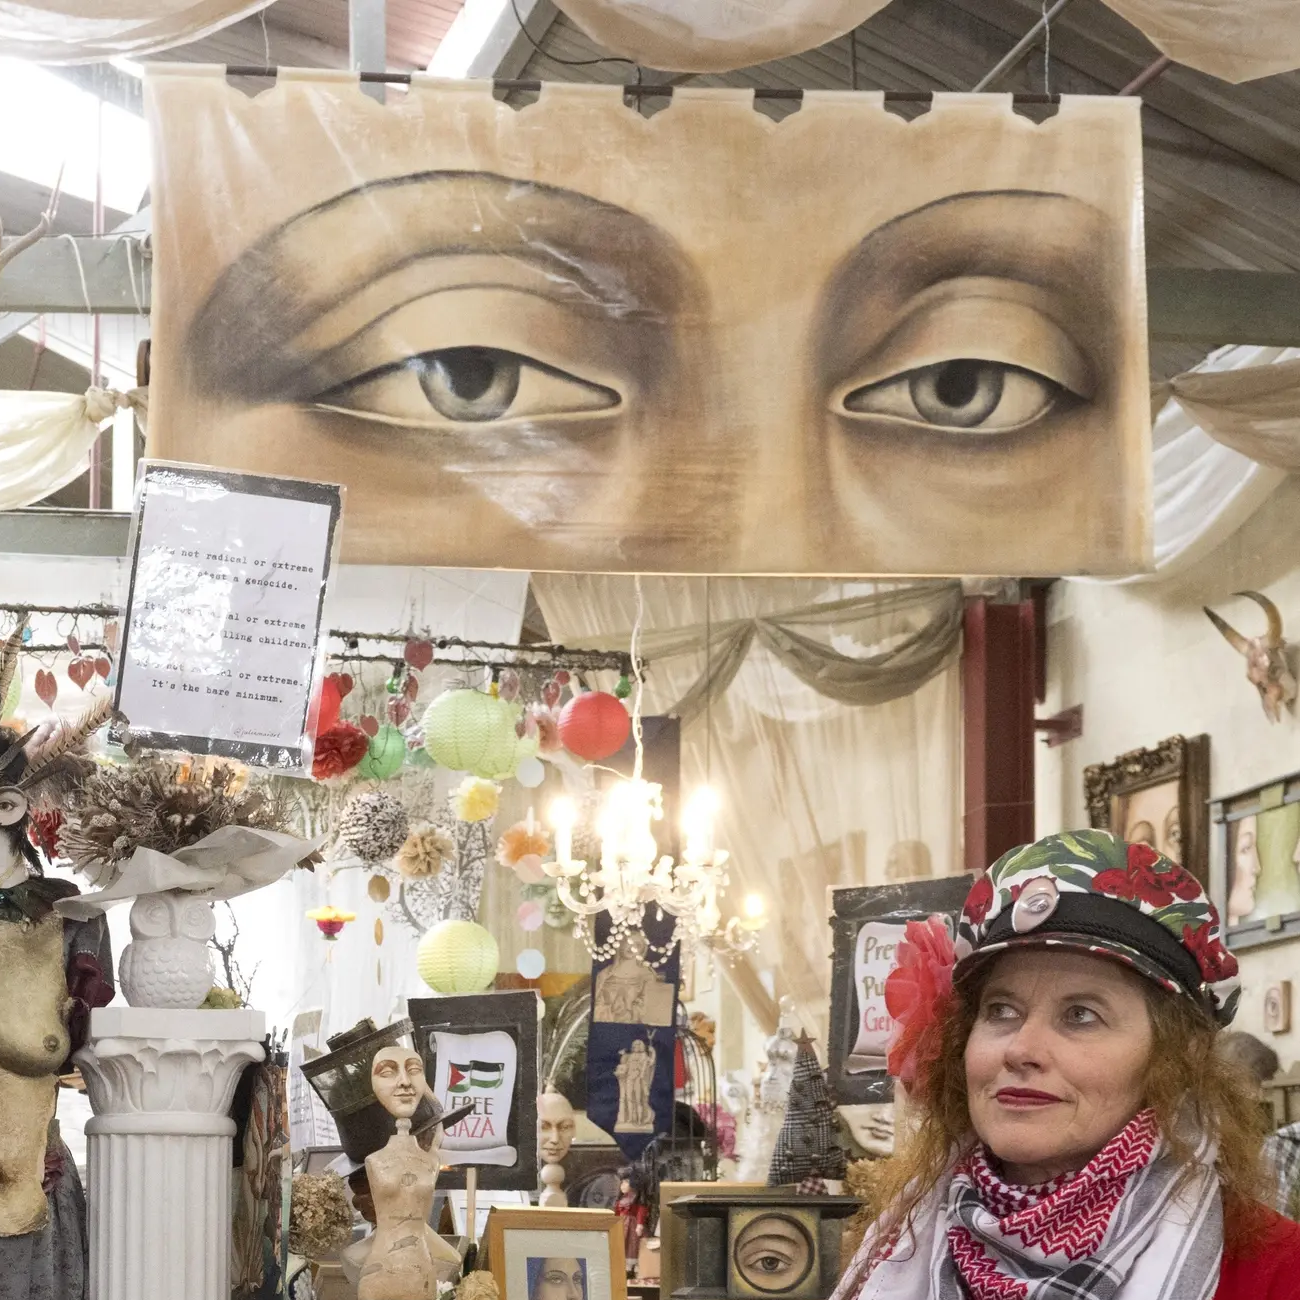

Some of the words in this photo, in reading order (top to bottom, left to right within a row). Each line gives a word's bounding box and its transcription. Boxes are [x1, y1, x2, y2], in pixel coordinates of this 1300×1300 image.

[181, 549, 200, 558] not
[206, 552, 248, 564] radical
[254, 559, 267, 567] or
[272, 562, 314, 573] extreme
[245, 577, 299, 591] genocide.
[247, 616, 259, 624] or
[264, 618, 306, 630] extreme
[259, 635, 312, 649] children.
[239, 672, 251, 680] or
[257, 674, 303, 687] extreme.
[152, 679, 176, 690] It's
[182, 683, 199, 693] the
[206, 687, 229, 696] bare
[236, 692, 283, 703] minimum.
[864, 936, 897, 964] Pre
[452, 1095, 494, 1115] FREE
[443, 1117, 495, 1138] GAZA
